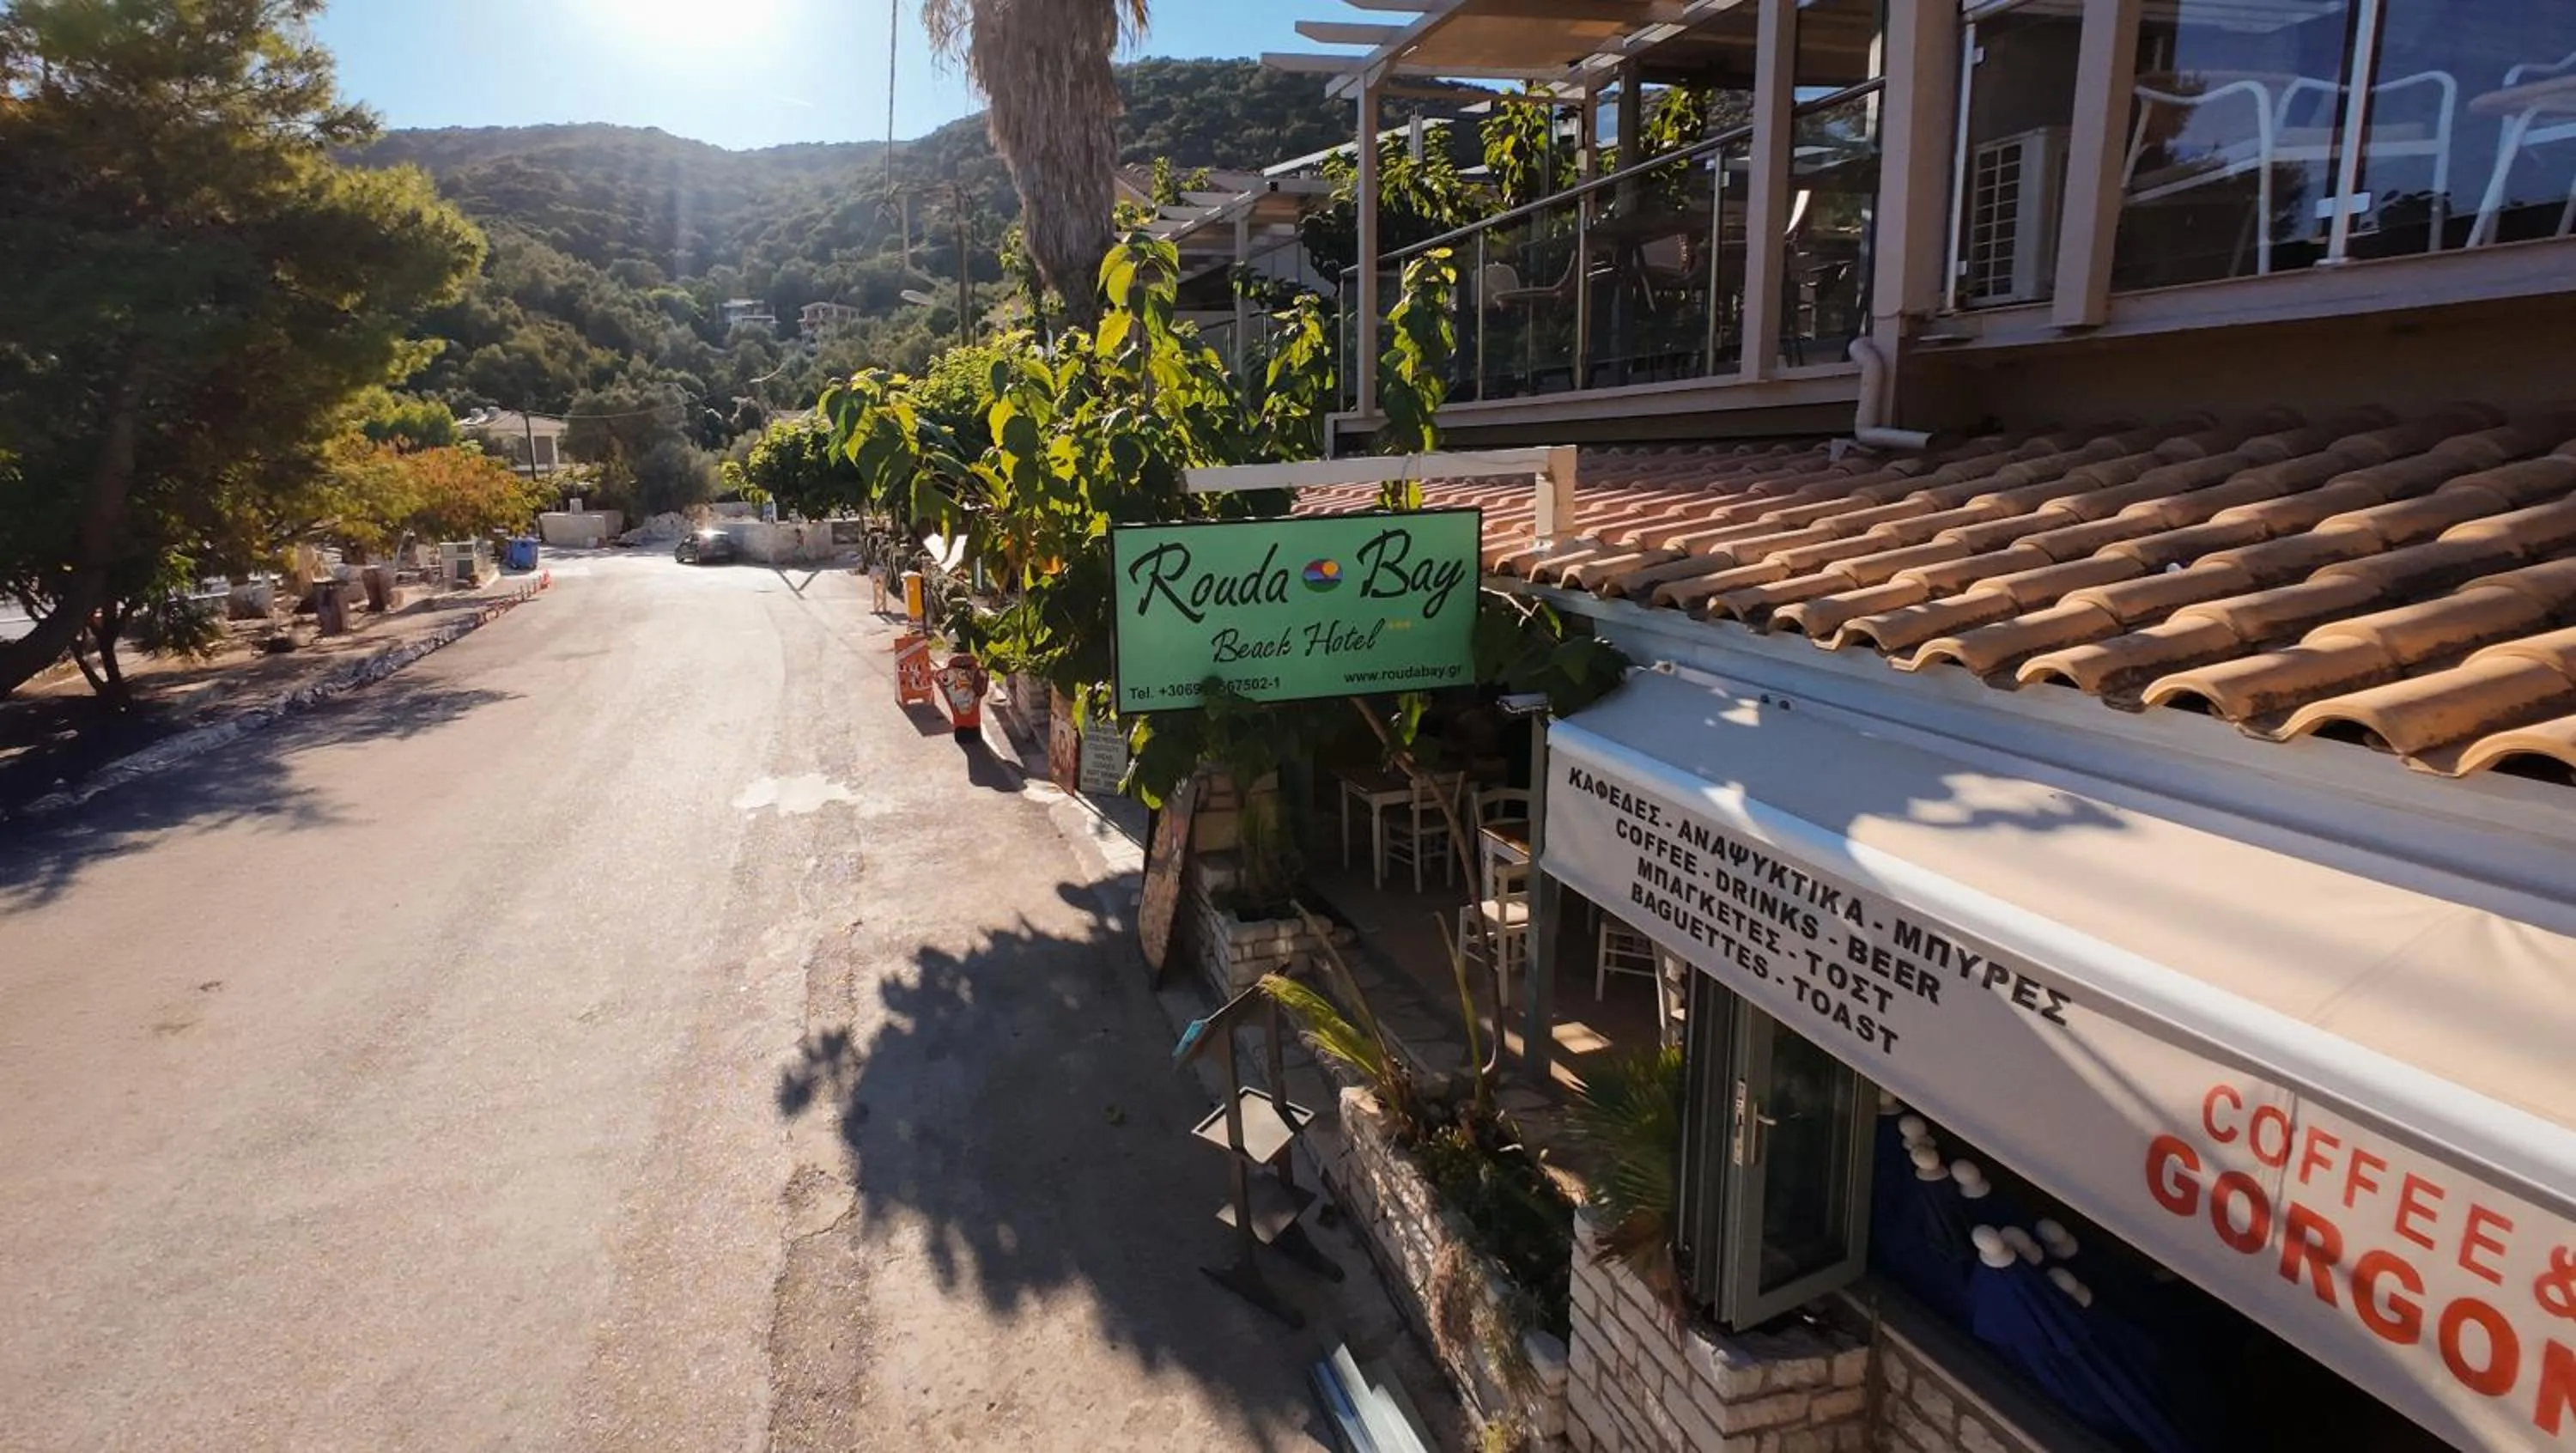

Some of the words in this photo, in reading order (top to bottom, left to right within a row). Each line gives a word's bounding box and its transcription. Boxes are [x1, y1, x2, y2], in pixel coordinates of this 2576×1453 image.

[1128, 542, 1290, 623] Rouda
[1357, 528, 1467, 619] Bay
[1211, 628, 1291, 663] Beach
[1303, 618, 1386, 657] Hotel
[1129, 687, 1154, 700] Tel.
[1344, 664, 1461, 683] www.roudabay.gr
[1569, 766, 1662, 828] ΚΑΦΕΔΕΣ
[1678, 819, 1865, 929] ΑΝΑΨΥΚΤΙΚΑ
[1893, 919, 2074, 1027] ΜΠΥΡΕΣ
[1615, 818, 1698, 871] COFFEE
[1716, 871, 1820, 943] DRINKS
[1848, 938, 1942, 1006] BEER
[1631, 882, 1770, 980] BAGUETTES
[1794, 978, 1900, 1055] TOAST
[1637, 857, 1782, 954] ΜΠΑΓΚΕΤΕΣ
[1806, 950, 1895, 1015] ΤΟΣΤ
[2202, 1085, 2514, 1287] COFFEE
